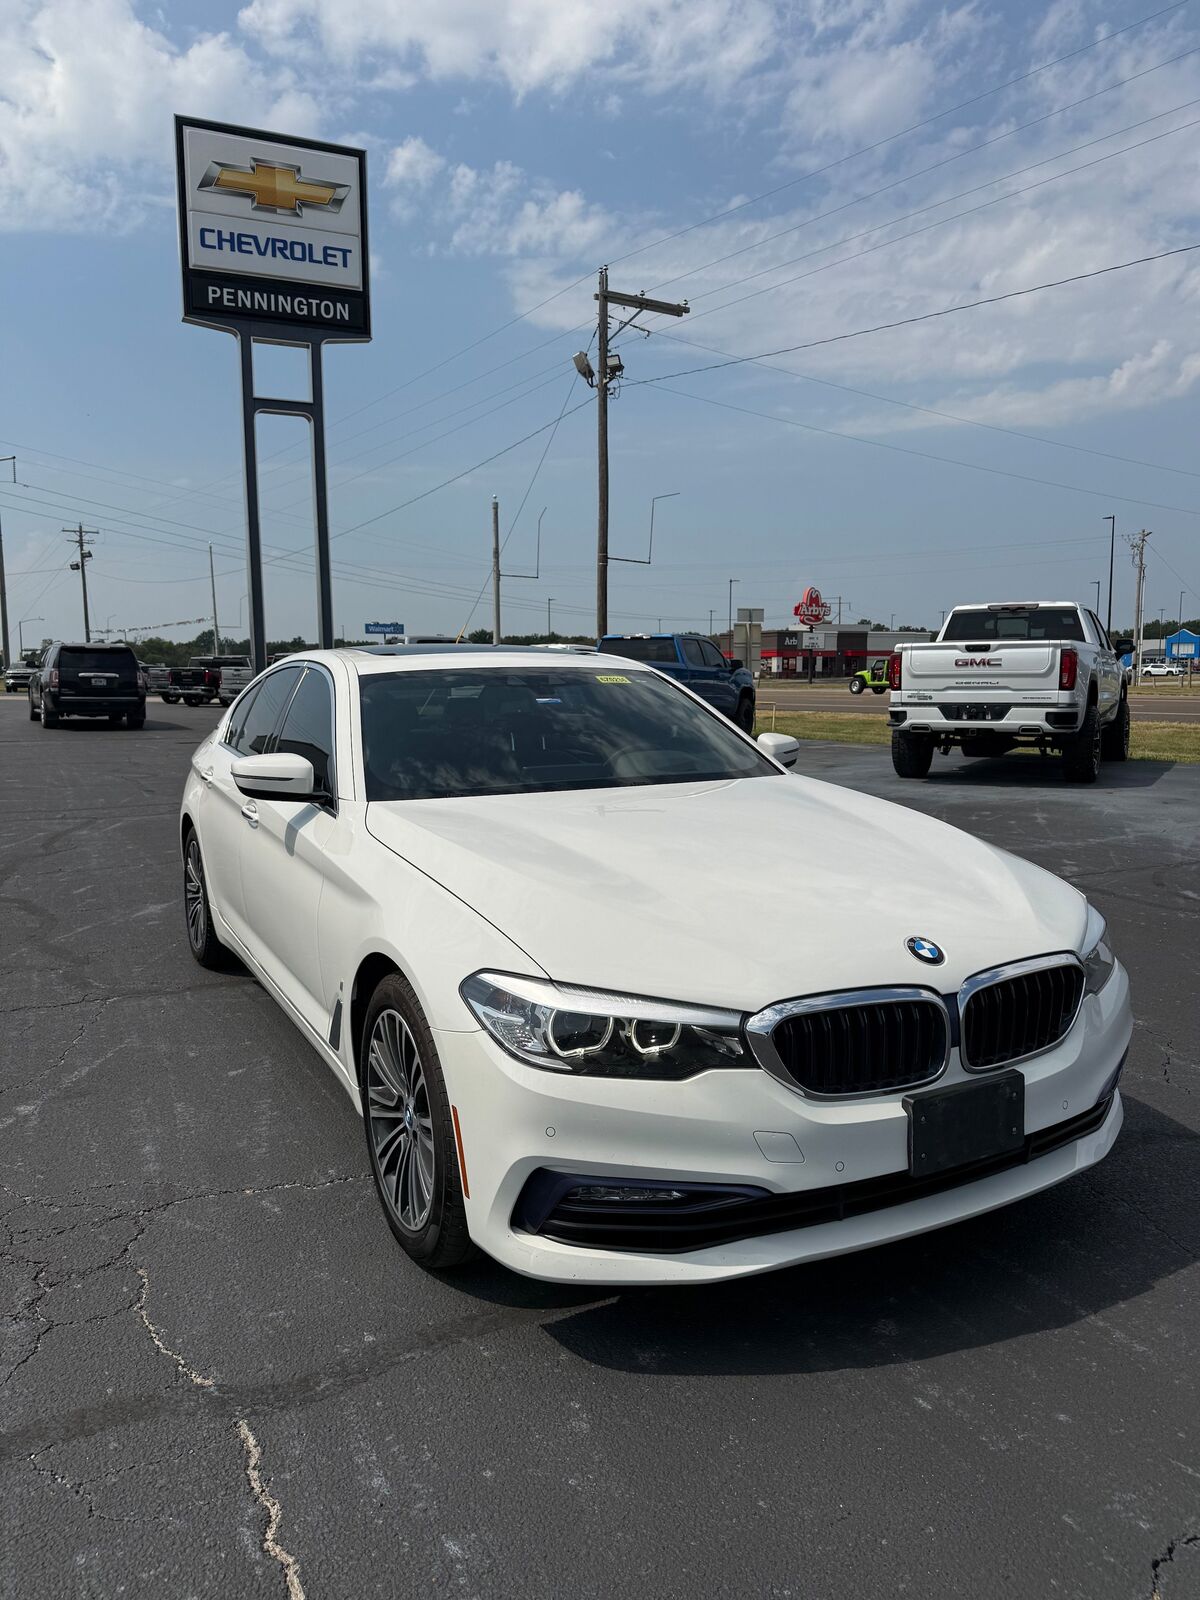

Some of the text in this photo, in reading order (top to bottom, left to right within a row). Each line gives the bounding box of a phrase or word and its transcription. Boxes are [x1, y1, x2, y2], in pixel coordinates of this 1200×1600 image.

[200, 227, 352, 268] CHEVROLET
[208, 286, 350, 320] PENNINGTON
[800, 604, 830, 617] Arby's
[954, 658, 1002, 667] GMC
